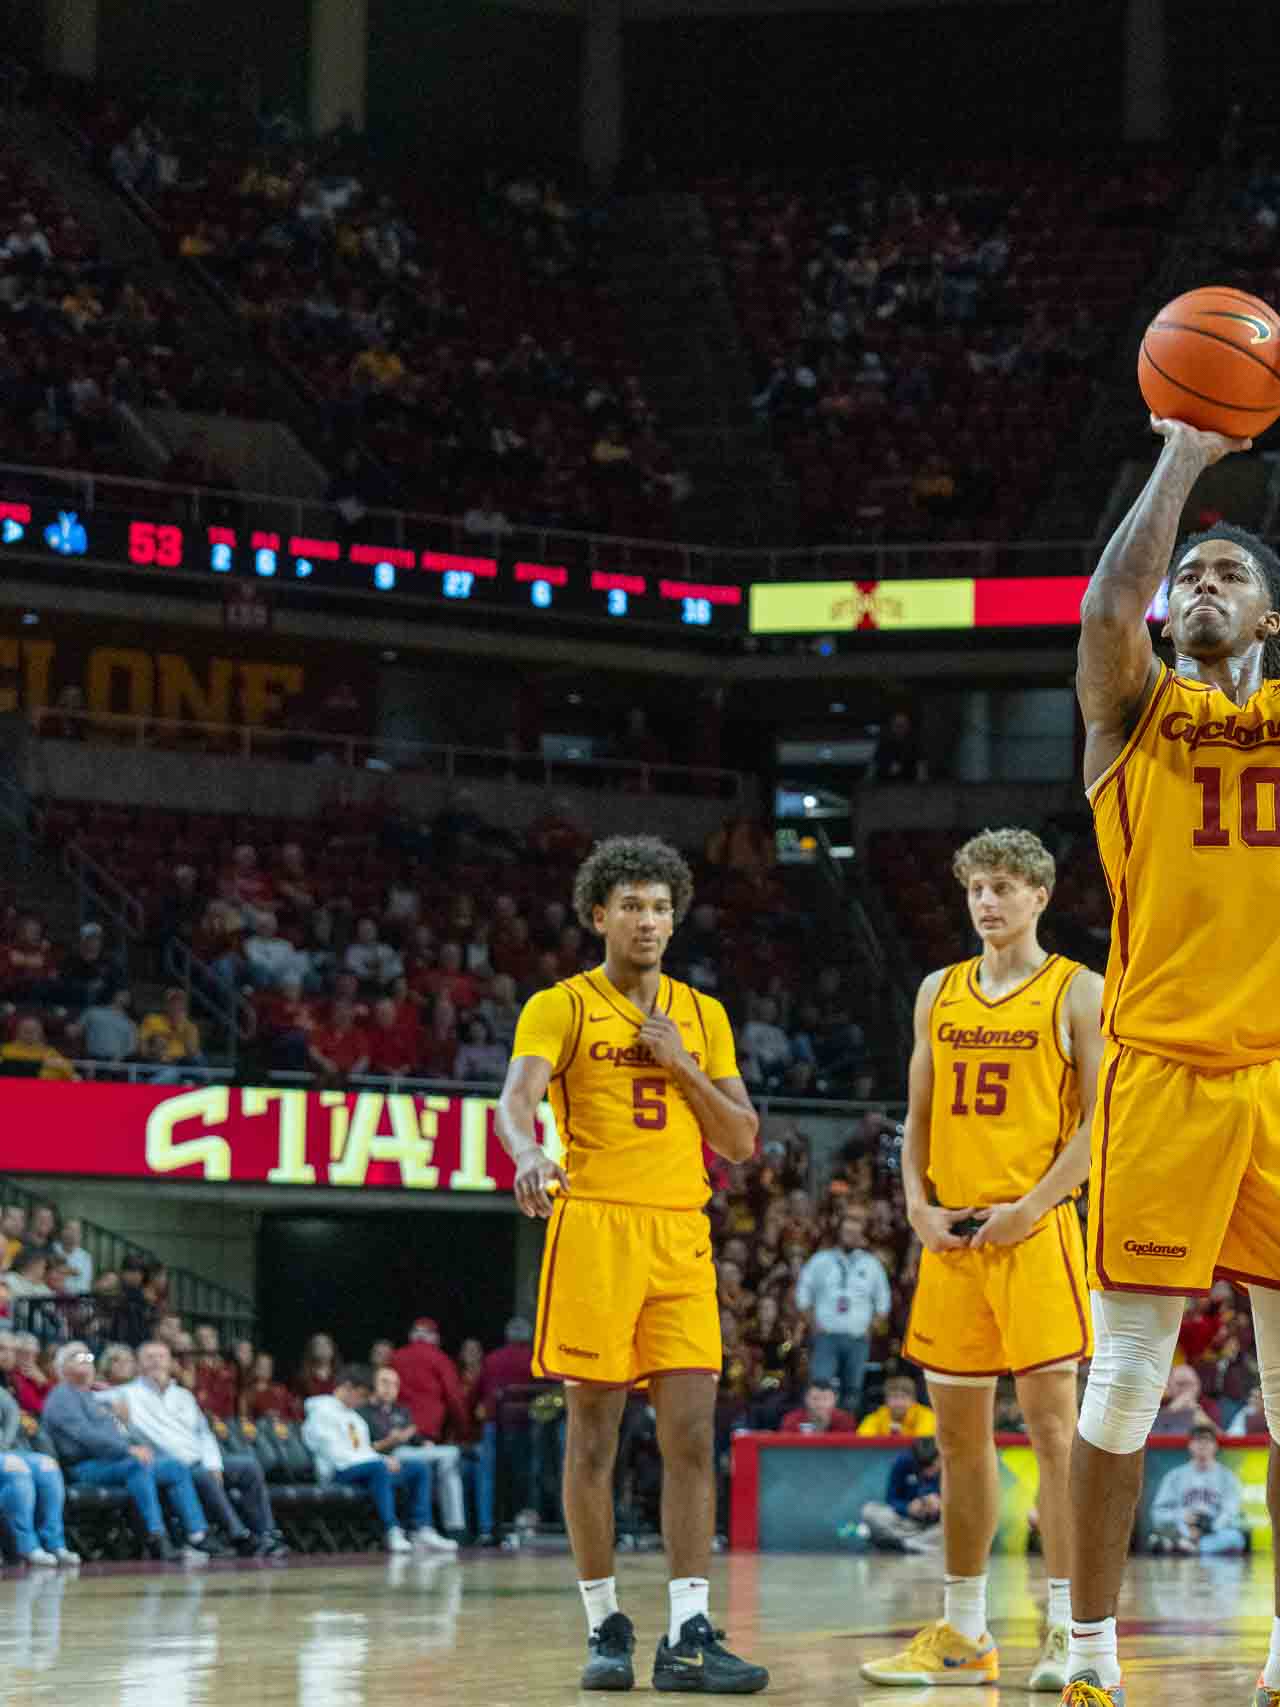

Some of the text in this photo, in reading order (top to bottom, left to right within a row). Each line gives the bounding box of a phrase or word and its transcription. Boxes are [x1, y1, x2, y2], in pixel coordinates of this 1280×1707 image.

[129, 522, 182, 566] 53
[938, 1022, 1039, 1050] Cyclones
[633, 1077, 667, 1130] 5
[951, 1062, 1010, 1115] 15
[1124, 1240, 1187, 1258] Cyclones
